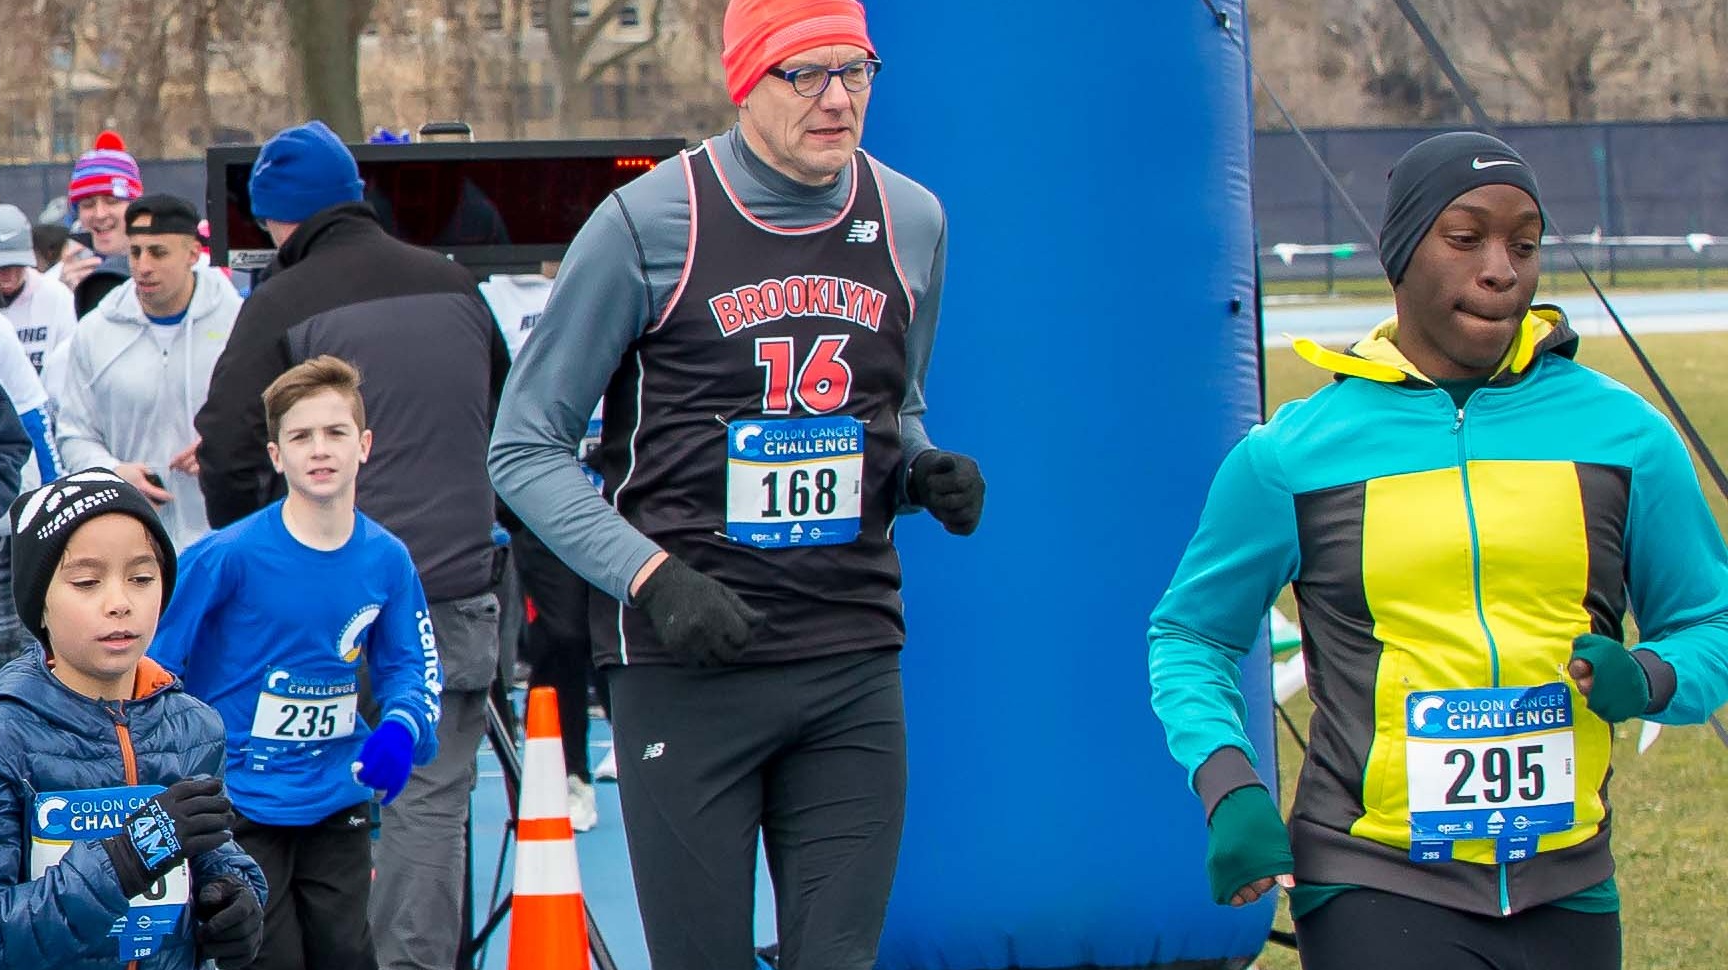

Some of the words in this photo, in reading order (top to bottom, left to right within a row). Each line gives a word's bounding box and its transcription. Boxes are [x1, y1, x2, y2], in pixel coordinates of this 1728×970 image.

[708, 275, 888, 337] BROOKLYN
[754, 333, 853, 415] 16
[763, 438, 858, 455] CHALLENGE
[764, 429, 806, 440] COLON
[810, 426, 858, 438] CANCER
[761, 468, 838, 517] 168
[288, 683, 356, 696] CHALLENGE
[1446, 700, 1504, 714] COLON
[1510, 694, 1565, 710] CANCER
[275, 704, 338, 738] 235
[1447, 708, 1566, 731] CHALLENGE
[1444, 744, 1544, 805] 295
[70, 799, 124, 815] COLON
[133, 816, 172, 868] 4M
